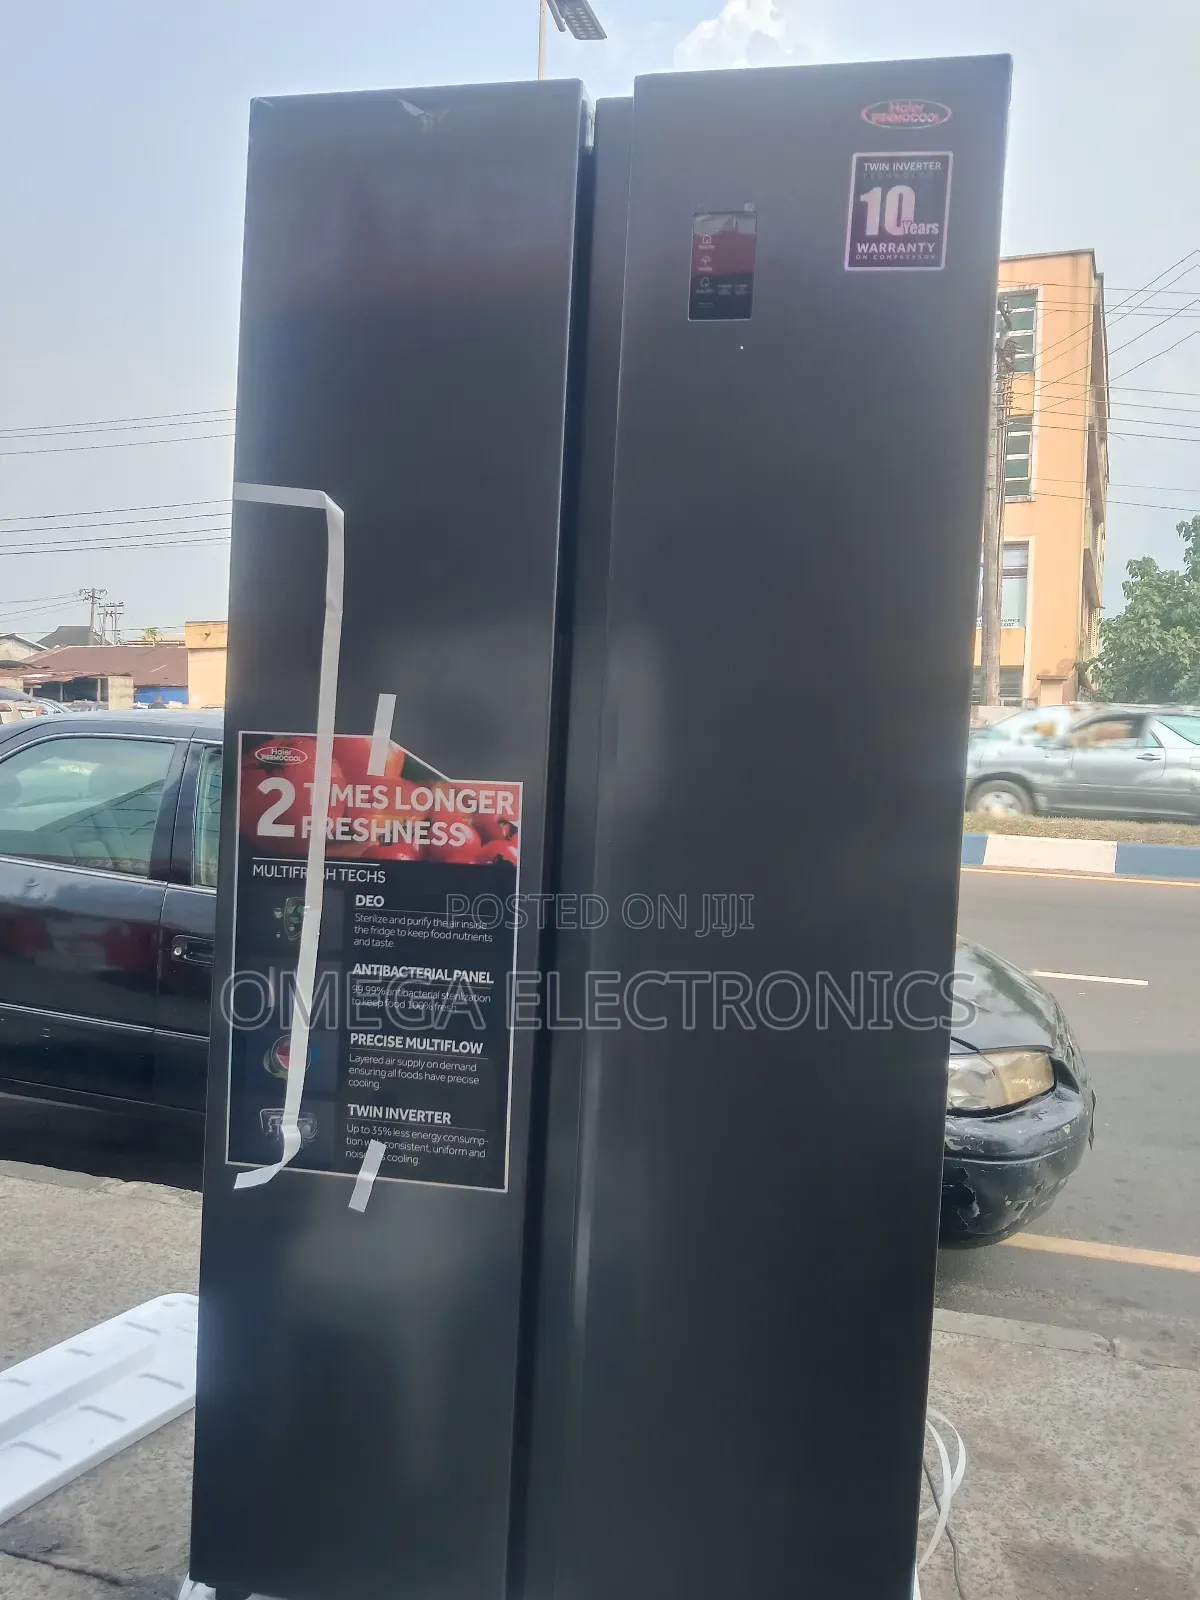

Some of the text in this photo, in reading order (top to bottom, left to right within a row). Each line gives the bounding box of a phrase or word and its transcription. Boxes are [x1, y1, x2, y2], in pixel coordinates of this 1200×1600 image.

[864, 161, 942, 171] TWIN INVERTER
[860, 185, 940, 236] 10 Years
[857, 242, 936, 252] WARRANTY
[271, 748, 292, 756] Haier
[304, 782, 514, 815] TMES LONGER
[257, 777, 296, 838] 2
[252, 864, 386, 884] MULTIFRH TECHS
[356, 894, 384, 907] DEO
[355, 913, 388, 924] Sterilize
[389, 916, 406, 924] and
[407, 918, 432, 928] purify
[433, 918, 447, 927] the
[462, 921, 488, 930] inside
[354, 925, 492, 942] the fridge to keep food nutrients
[354, 938, 396, 948] and taste.
[352, 963, 494, 984] ANTIBACTERIAL PANEL
[352, 984, 385, 996] 99.99%
[386, 988, 440, 1000] antibacterial
[352, 997, 361, 1006] to
[362, 998, 384, 1008] keep
[385, 999, 406, 1008] food
[350, 1033, 484, 1054] PRECISE MULTIFLOW
[350, 1054, 384, 1065] Layered
[386, 1056, 396, 1064] air
[398, 1058, 426, 1069] supply
[440, 1061, 476, 1072] demand
[348, 1078, 381, 1090] cooling.
[349, 1067, 480, 1084] ensuring all foods have precise
[348, 1104, 452, 1124] TWIN INVERTER
[346, 1124, 488, 1146] Up to 35% less energy consump-
[346, 1136, 362, 1146] tion
[432, 1144, 467, 1155] uniform
[468, 1148, 486, 1158] and
[386, 1154, 420, 1166] cooling.
